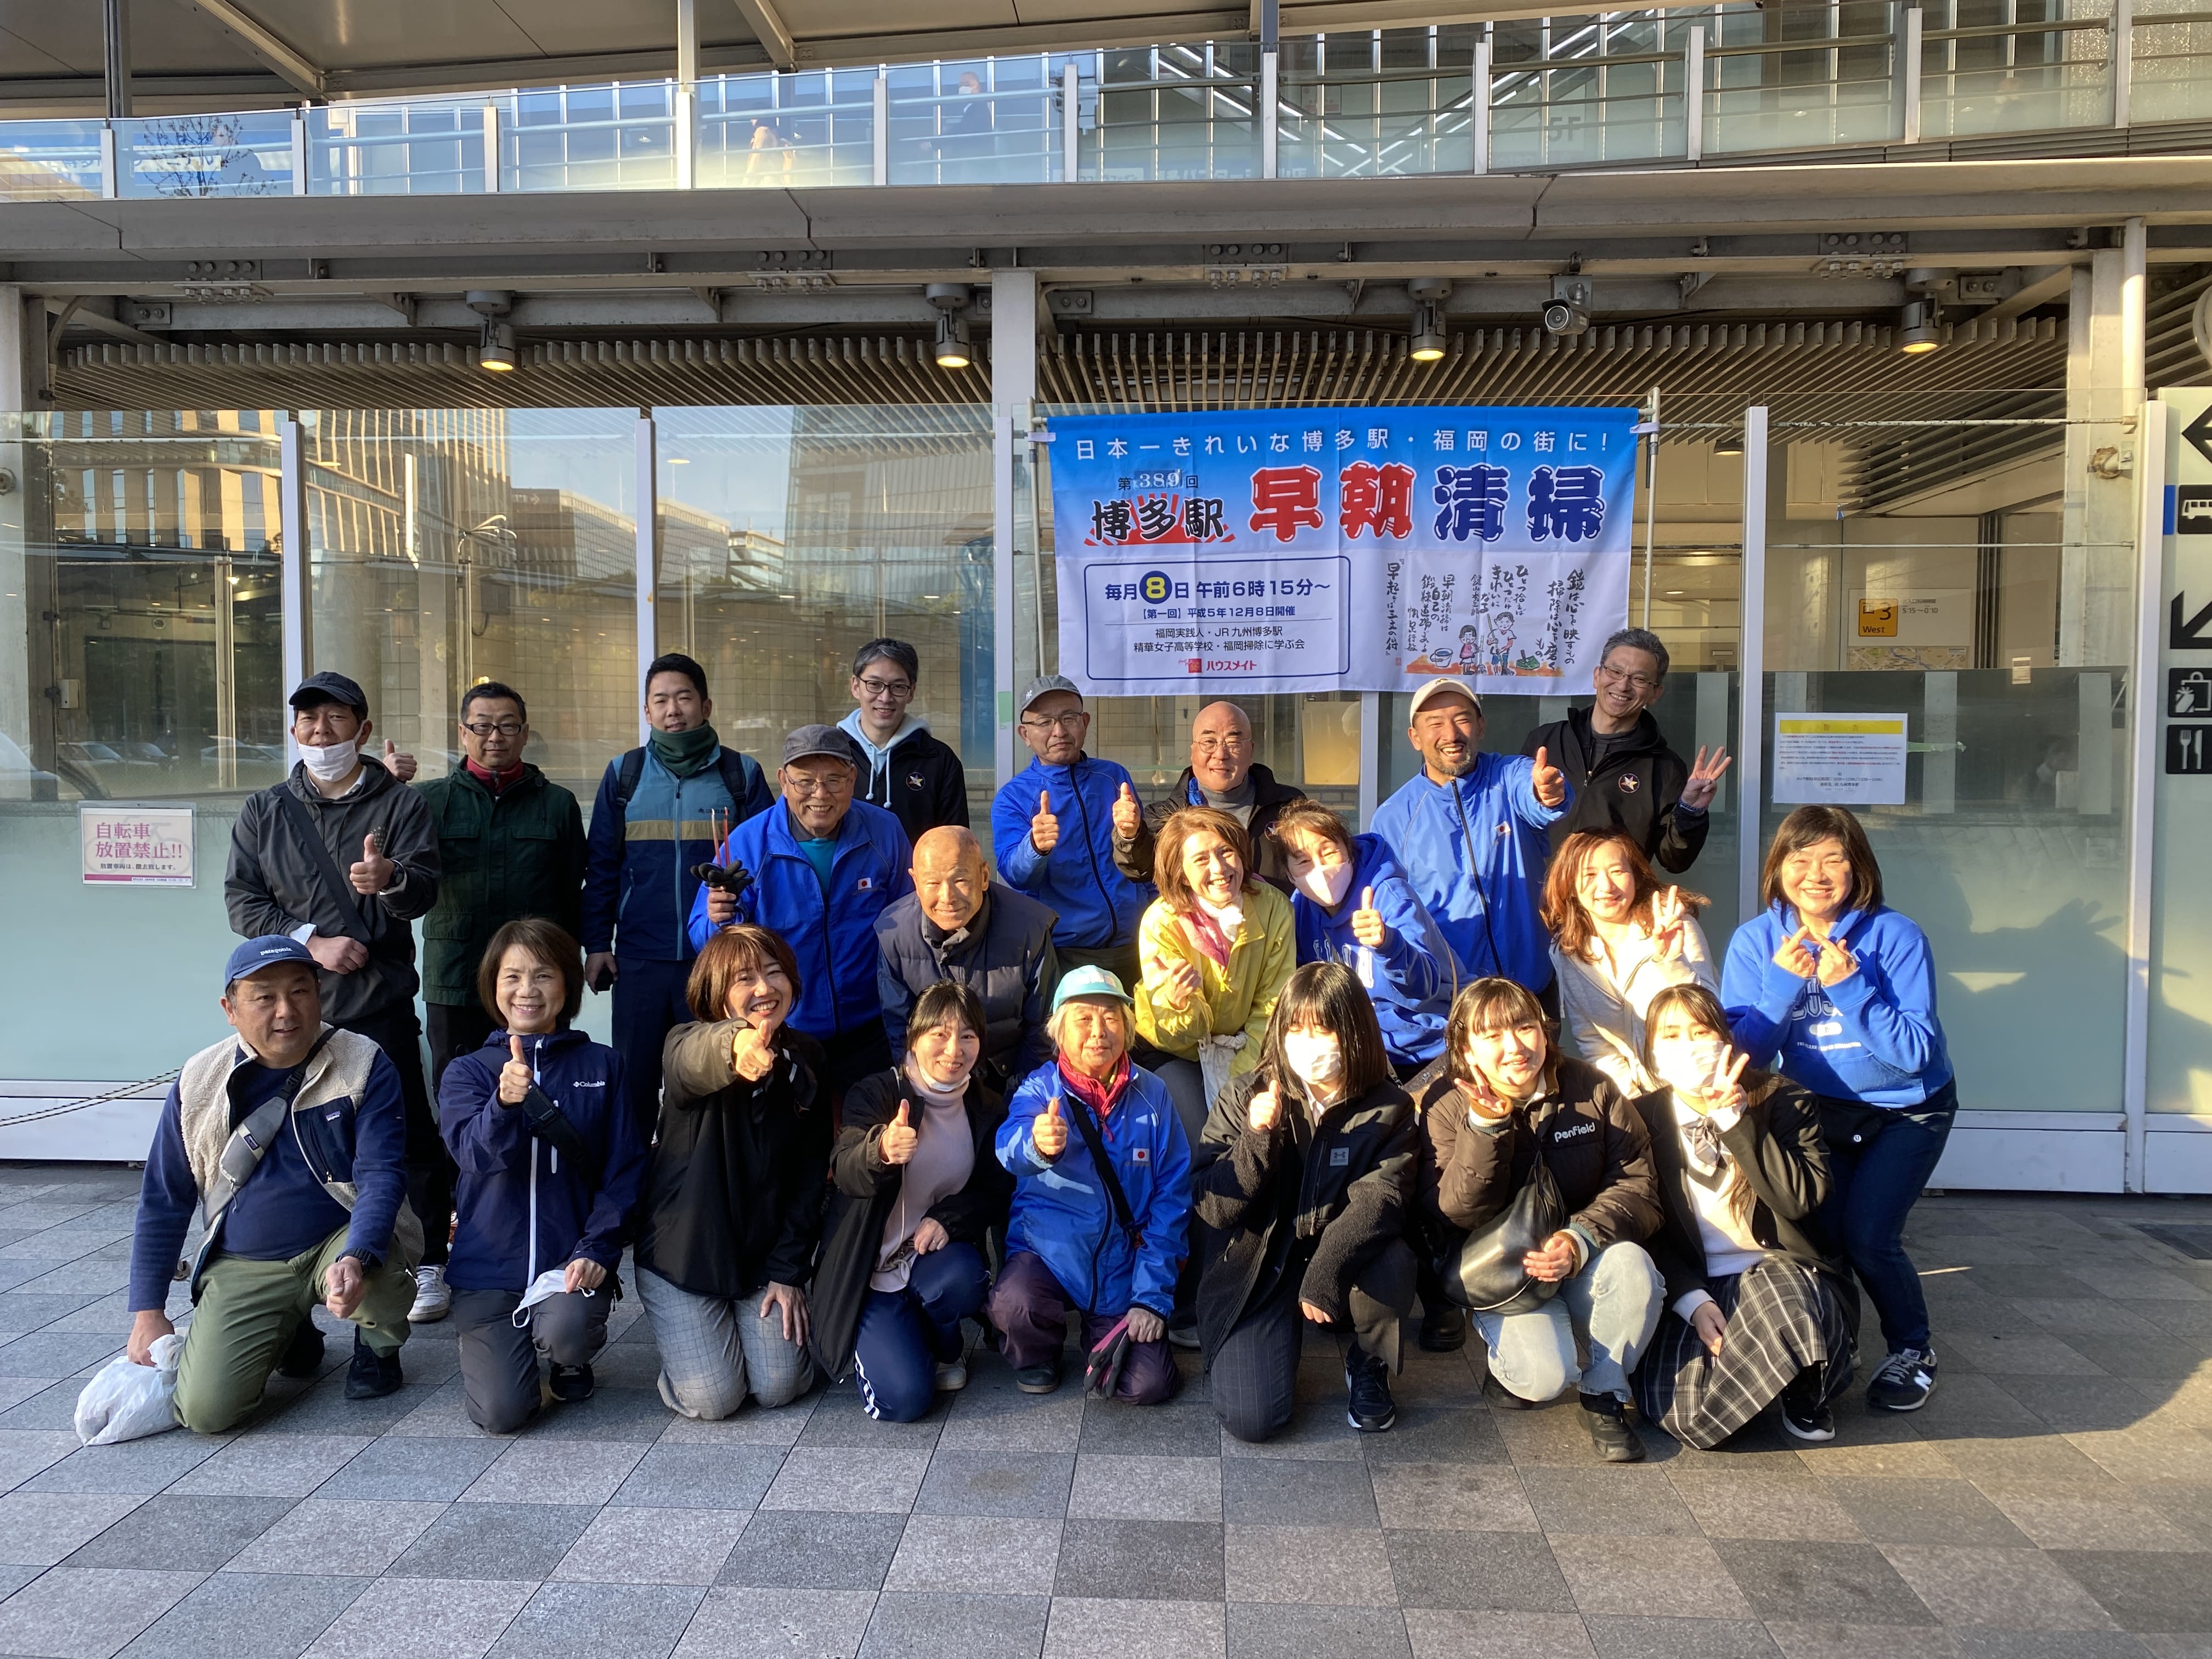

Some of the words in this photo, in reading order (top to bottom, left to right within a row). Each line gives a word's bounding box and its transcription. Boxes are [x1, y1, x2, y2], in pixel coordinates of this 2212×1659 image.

[1076, 428, 1607, 460] 日本一きれいな博多駅・福岡の街に!
[1092, 498, 1224, 541] 博多駅
[1250, 461, 1605, 543] 早朝清掃
[1879, 602, 1892, 620] 3
[1133, 639, 1305, 653] 精華女子高等学校・福岡掃除に学ぶ会
[1206, 660, 1257, 671] ハウスメイト
[97, 822, 150, 839] 自転車
[95, 841, 183, 859] 放置禁止!!
